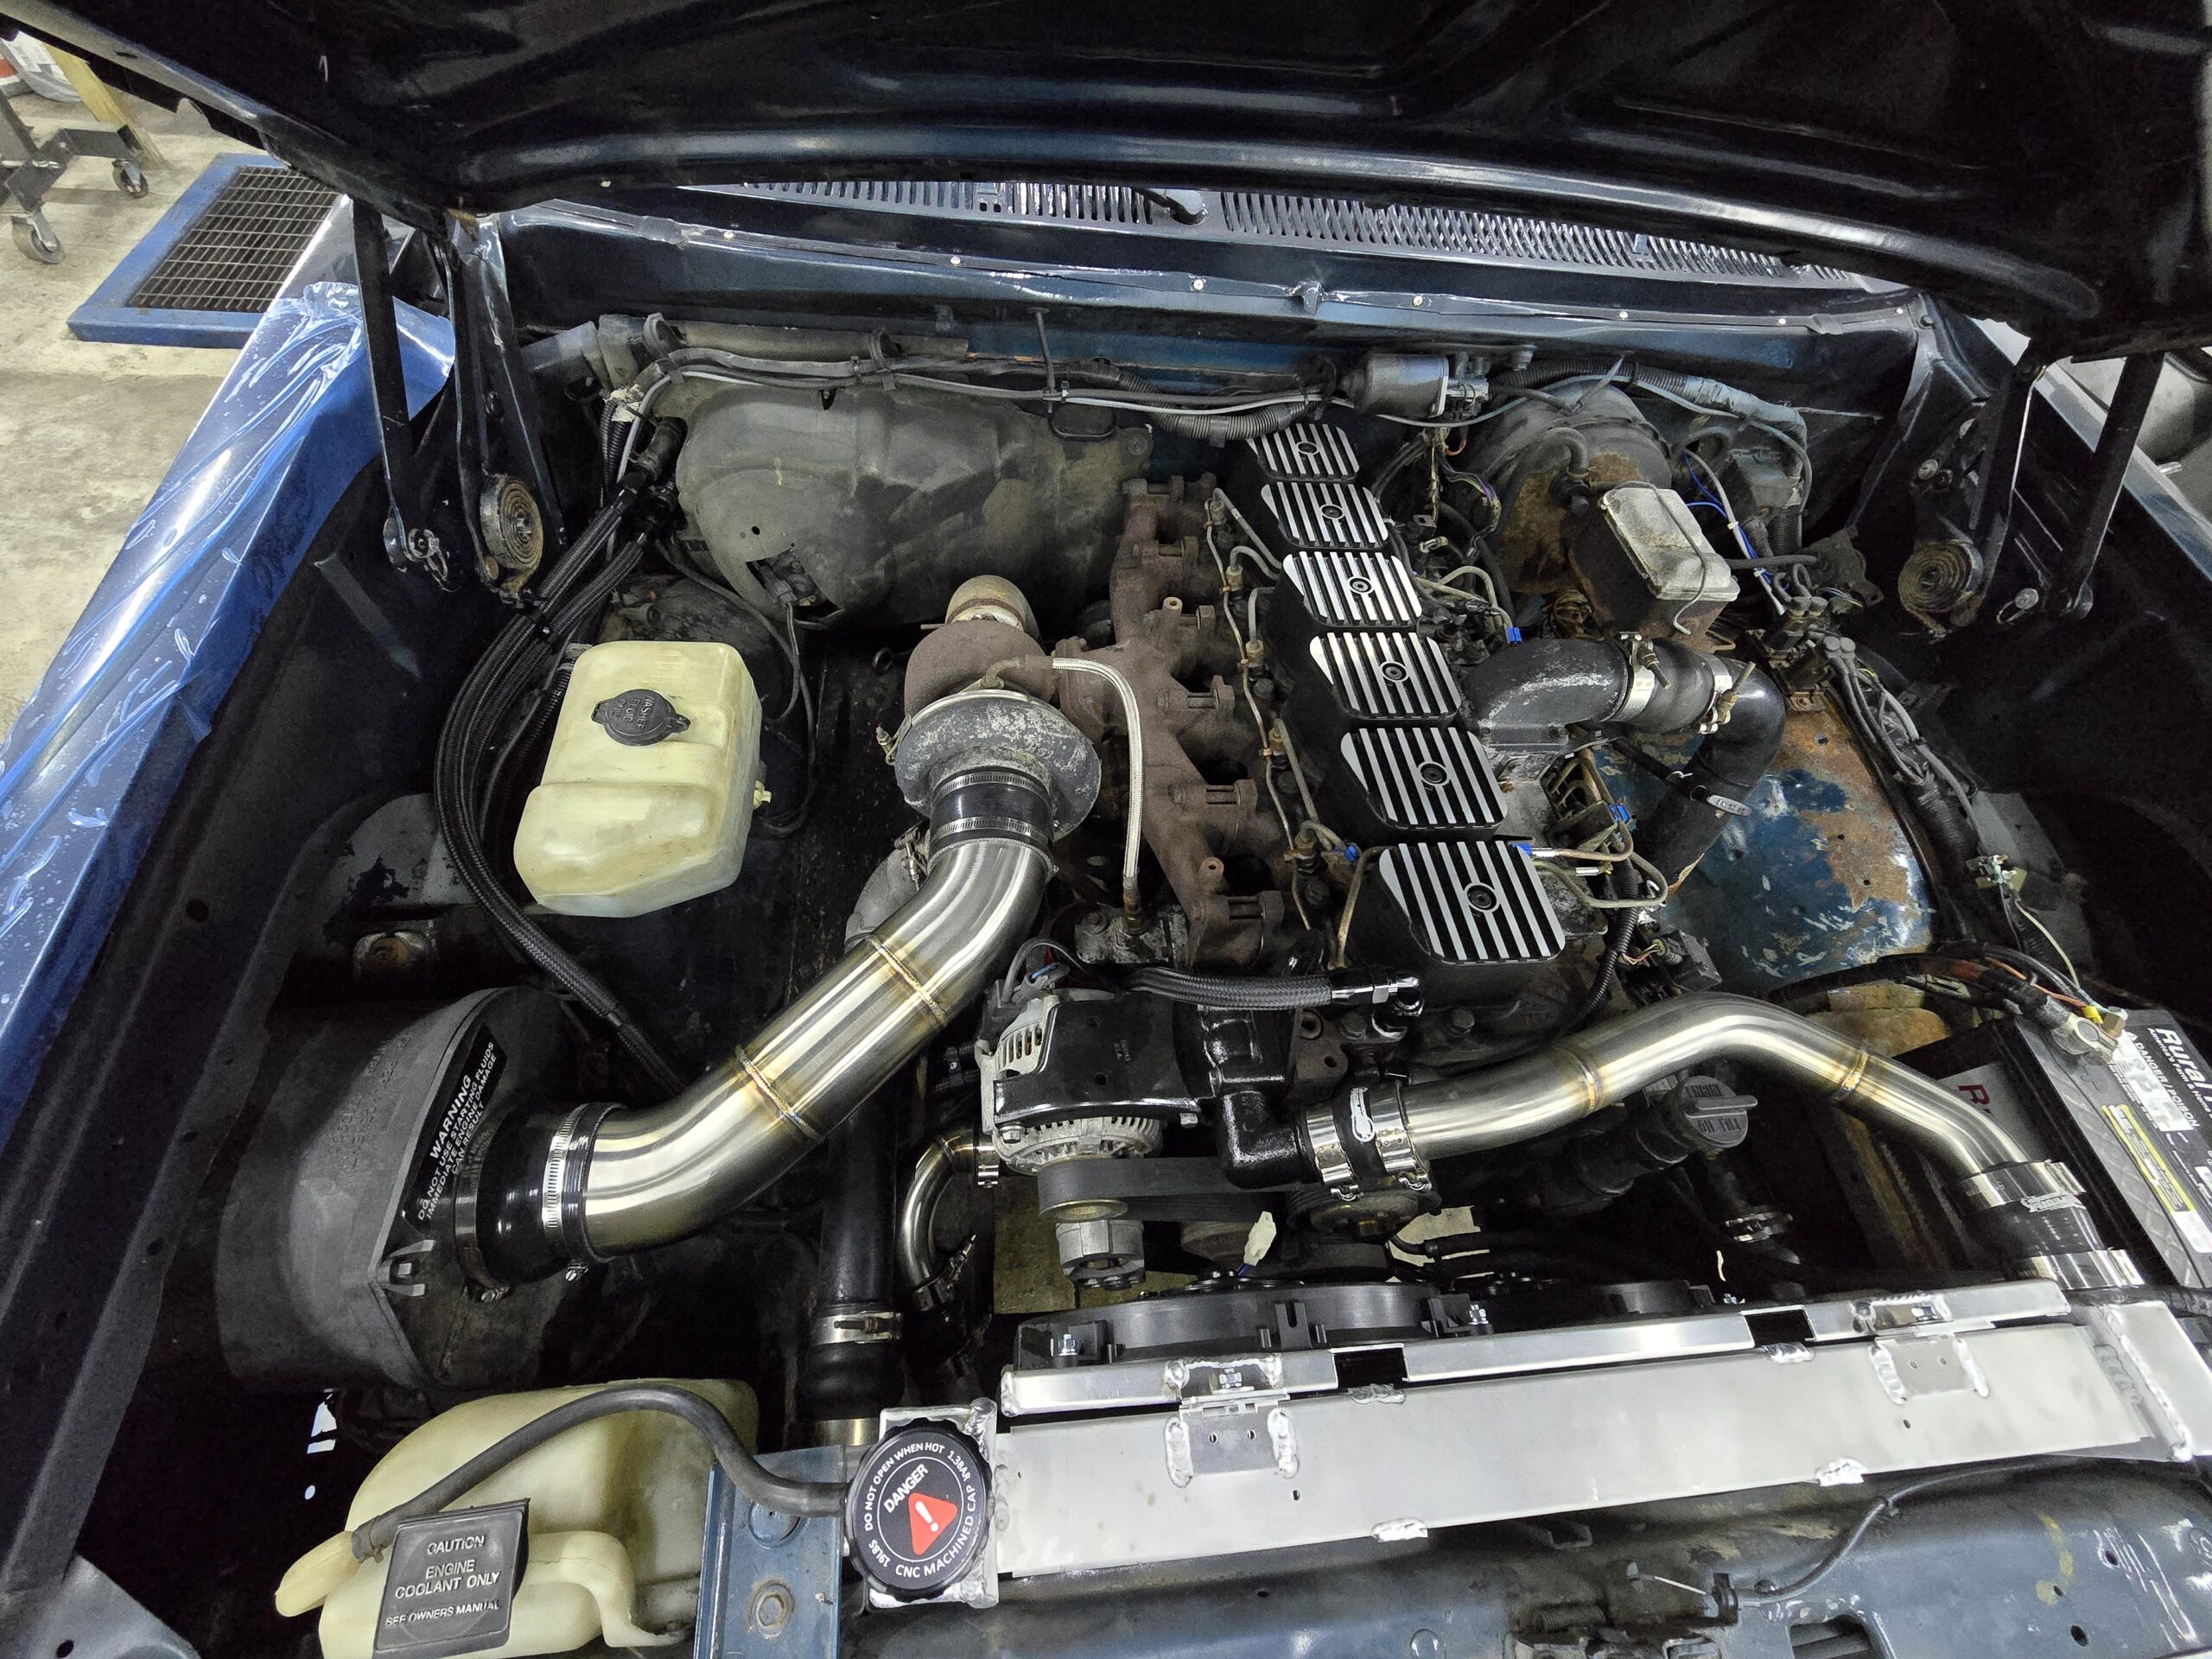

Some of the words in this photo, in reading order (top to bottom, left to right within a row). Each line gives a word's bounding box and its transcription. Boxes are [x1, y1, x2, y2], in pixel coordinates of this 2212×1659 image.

[2135, 1042, 2169, 1084] DANGER
[418, 1198, 430, 1221] DO
[427, 1167, 442, 1197] NOT
[439, 1140, 454, 1167] USE
[450, 1082, 478, 1139] STARTING
[475, 1041, 494, 1082] FLUIDS
[430, 1074, 472, 1160] WARNING
[426, 1148, 458, 1220] IMMEDIATE
[454, 1101, 478, 1147] ENGINE
[474, 1052, 497, 1100] DAMAGE
[451, 1147, 465, 1174] CAN
[463, 1103, 484, 1147] RESULT
[893, 1442, 924, 1461] WHEN
[925, 1442, 945, 1454] HOT
[873, 1457, 895, 1485] OPEN
[865, 1484, 878, 1511] NOT
[883, 1464, 929, 1514] DANGER
[864, 1513, 874, 1531] DO
[895, 1564, 921, 1579] CNC
[923, 1516, 974, 1577] MACHINED
[965, 1484, 976, 1512] CAP
[426, 1535, 486, 1556] CAUTION
[868, 1539, 891, 1567] 19LBS
[424, 1559, 476, 1580] ENGINE
[394, 1577, 463, 1599] COOLANT
[466, 1571, 501, 1590] ONLY
[385, 1615, 407, 1628] SEE
[407, 1605, 455, 1624] OWNERS
[455, 1599, 500, 1616] MANUAL
